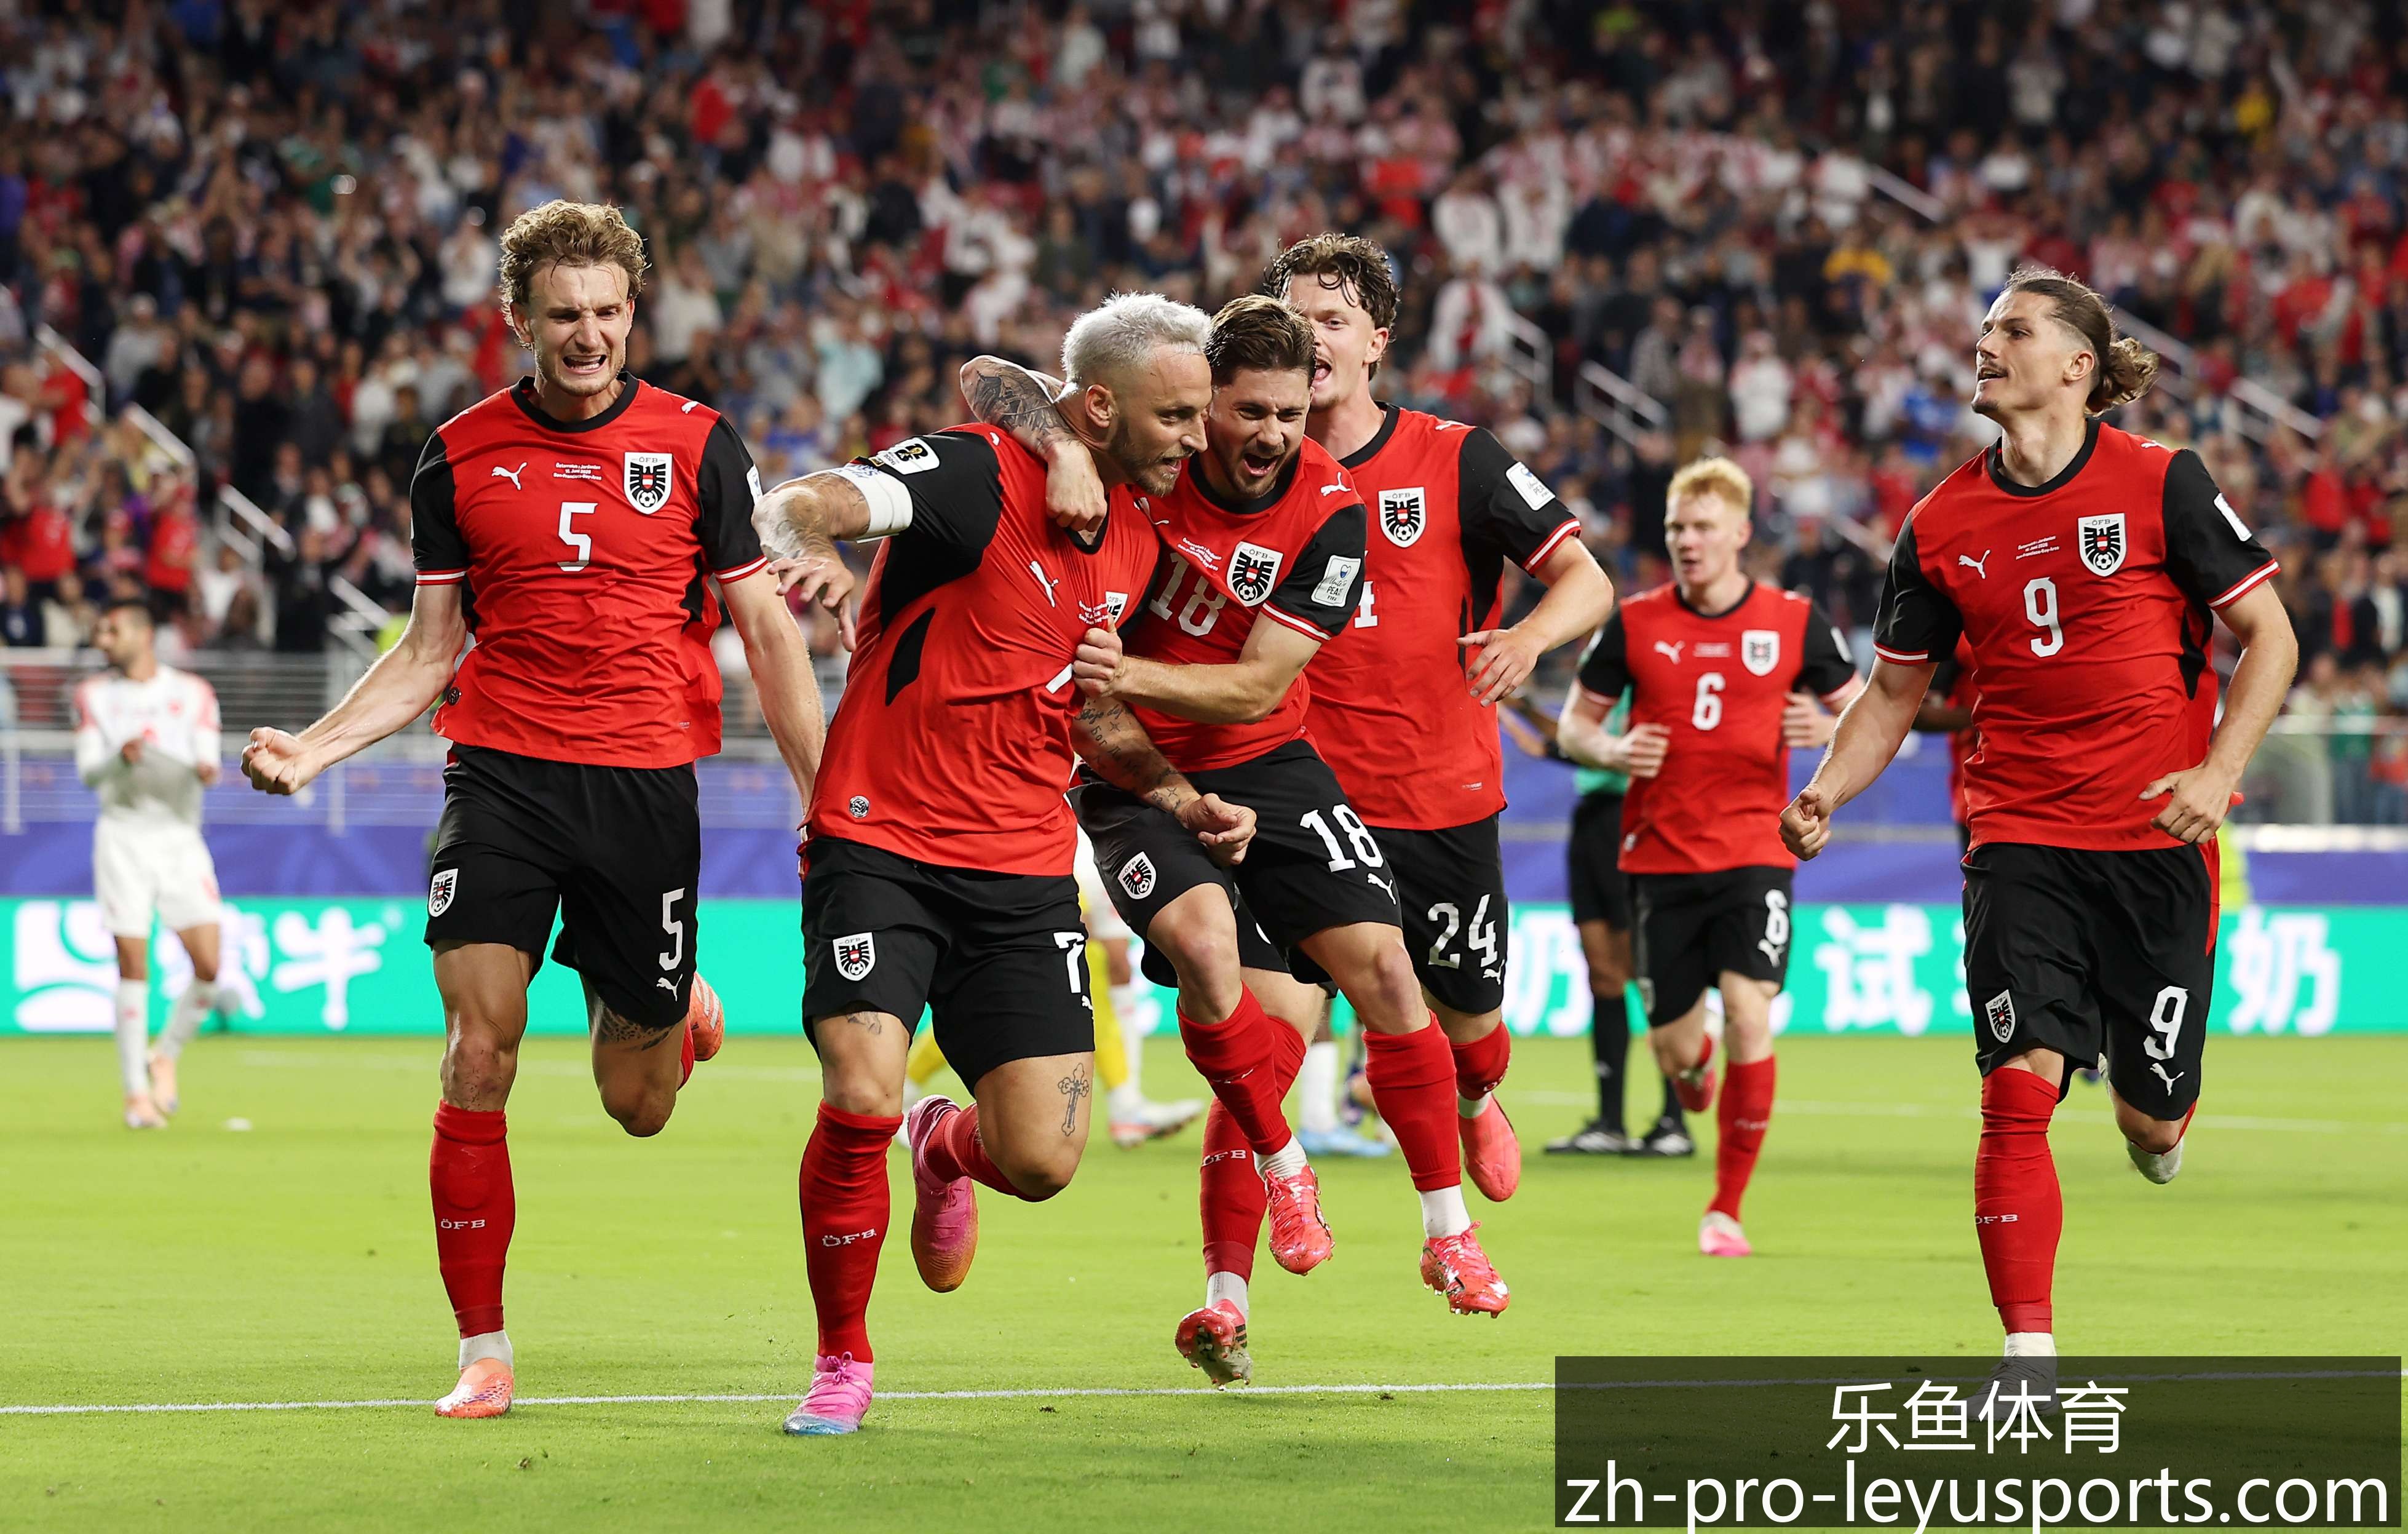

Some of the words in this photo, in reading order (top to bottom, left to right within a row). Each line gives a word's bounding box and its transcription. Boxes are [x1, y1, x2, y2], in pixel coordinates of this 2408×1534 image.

[556, 502, 598, 572] 5
[1149, 552, 1227, 637] 18
[2024, 577, 2063, 658] 9
[1692, 672, 1726, 731] 6
[1299, 803, 1384, 872] 18
[659, 888, 685, 971] 5
[1427, 894, 1498, 969] 24
[1764, 889, 1790, 945] 6
[1053, 932, 1085, 993] 7
[2227, 905, 2342, 1036] 奶
[2144, 985, 2188, 1060] 9
[440, 1218, 486, 1230] ÖFB
[822, 1228, 877, 1247] ÖFB
